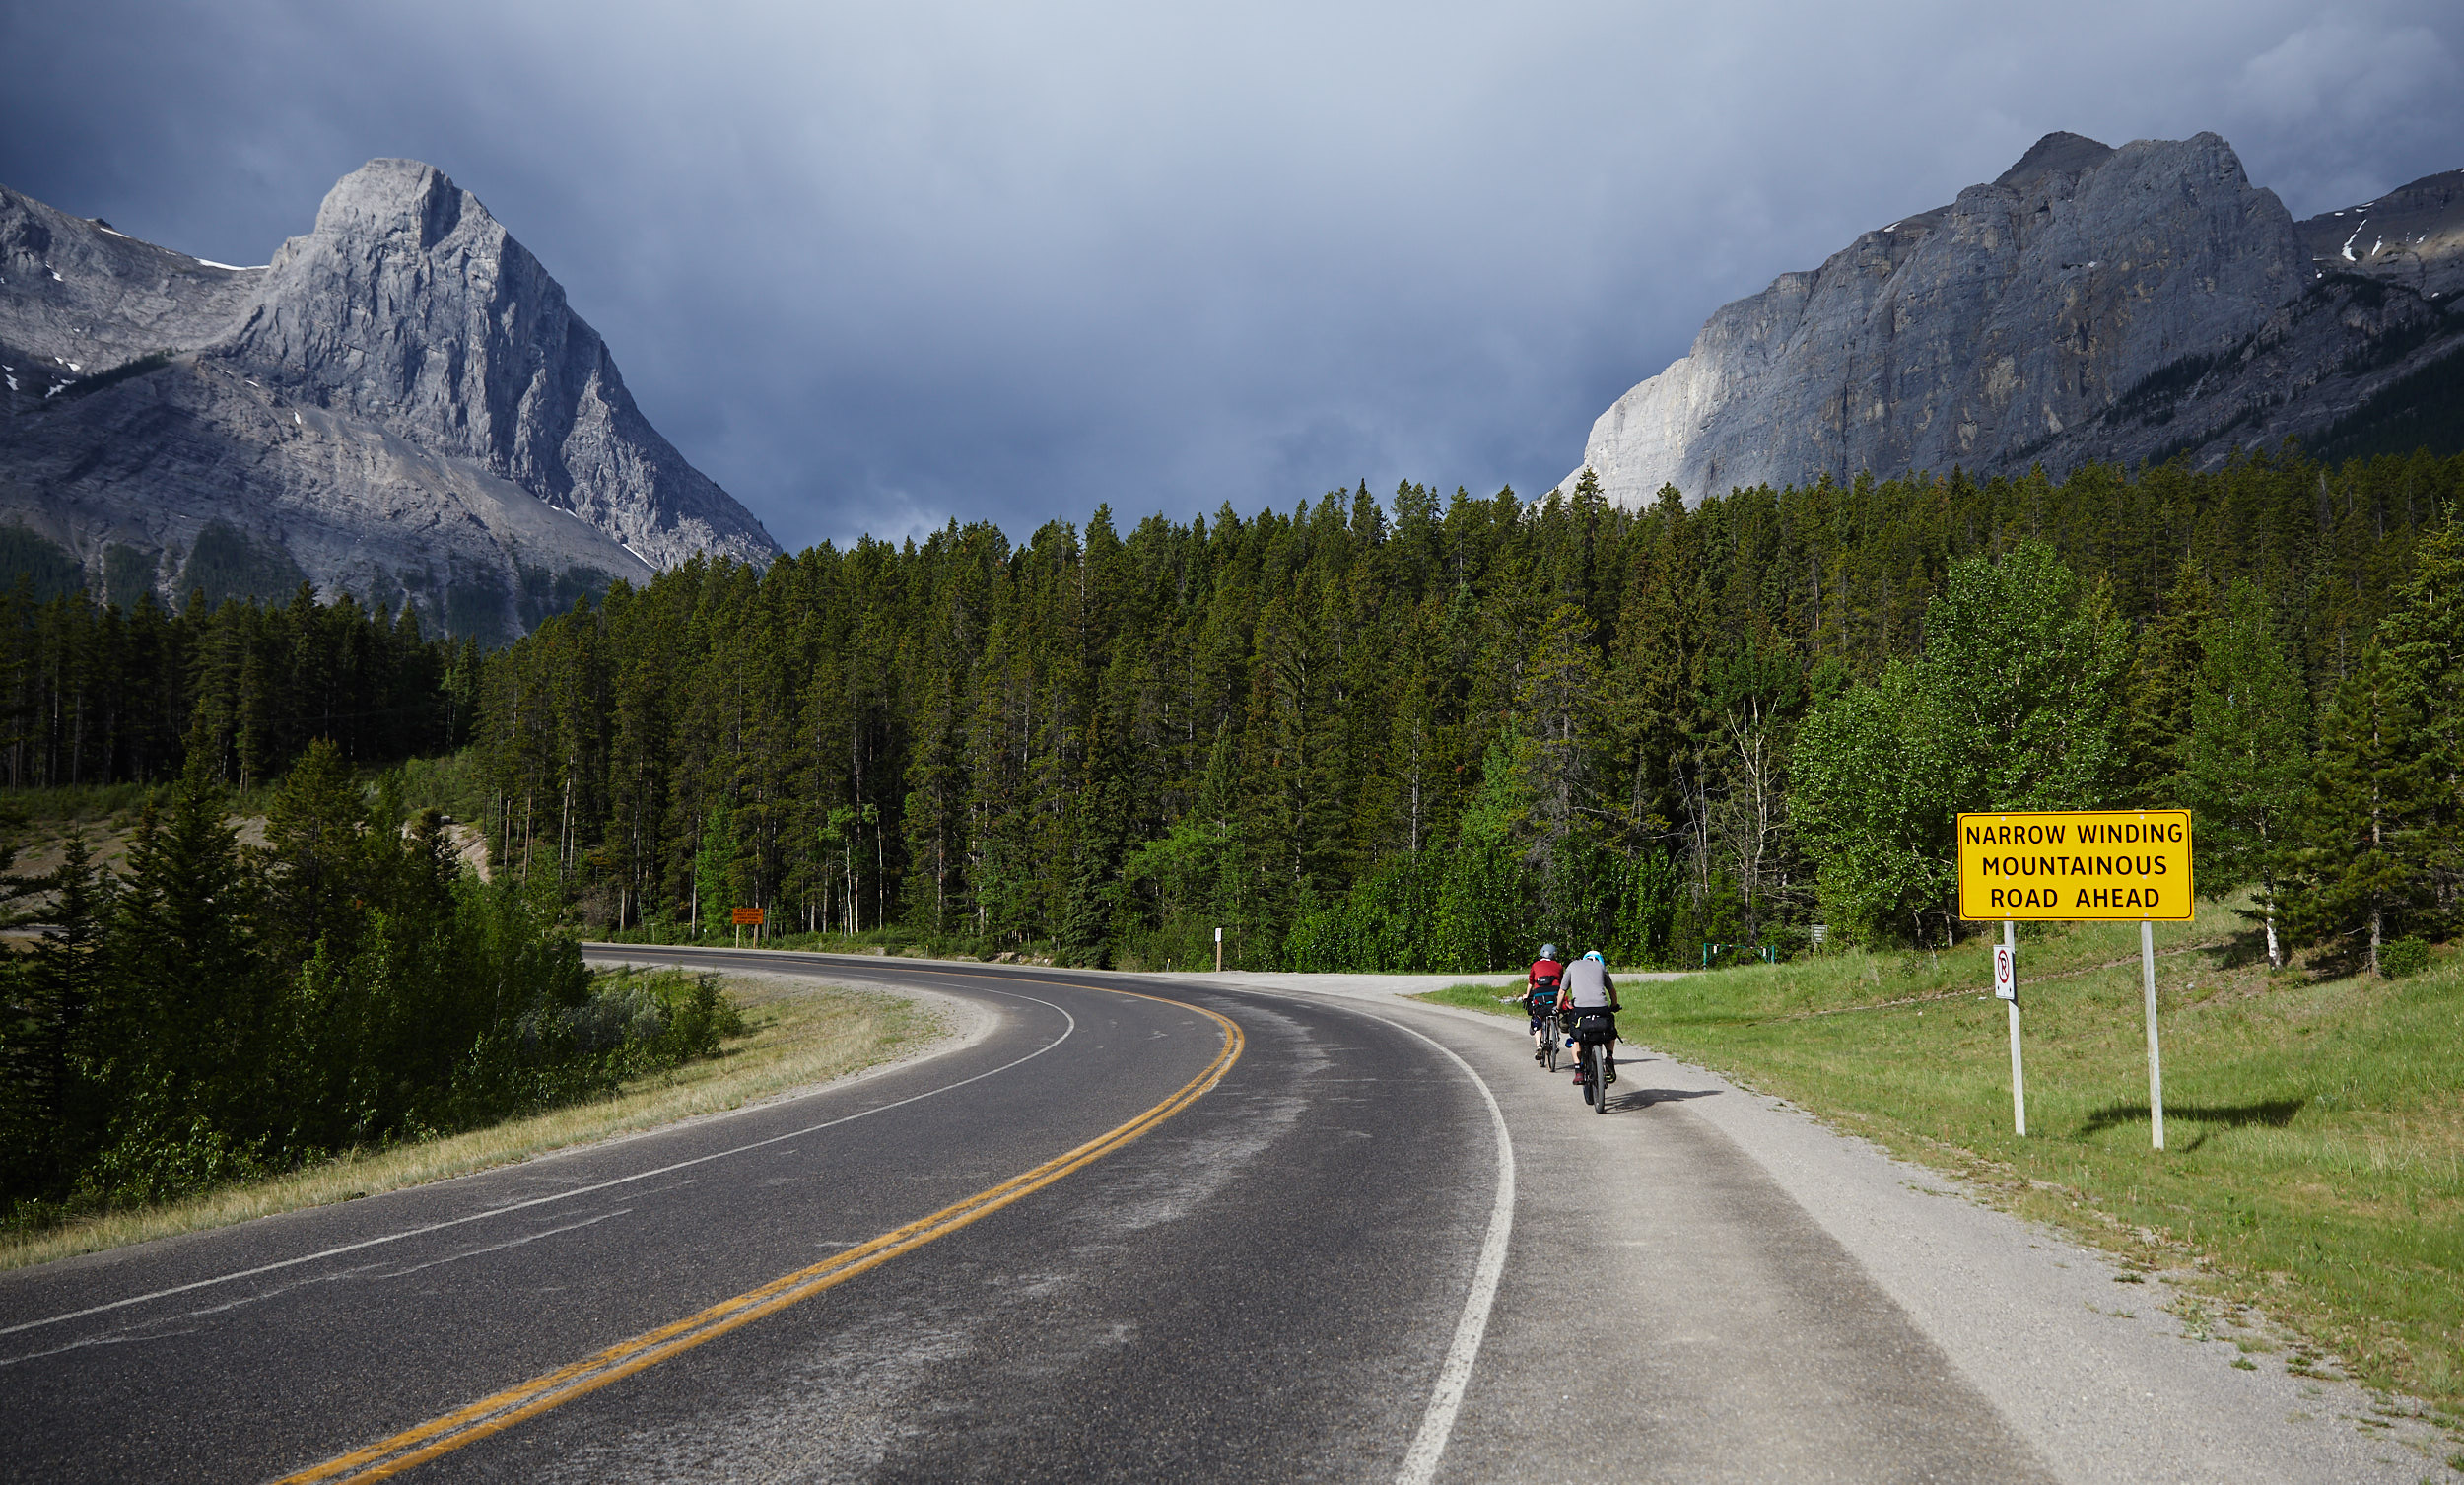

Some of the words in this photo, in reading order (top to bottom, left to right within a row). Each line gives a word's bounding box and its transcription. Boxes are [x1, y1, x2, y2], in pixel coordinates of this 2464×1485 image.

[1966, 825, 2066, 844] NARROW
[2077, 823, 2183, 844] WINDING
[1982, 855, 2167, 876] MOUNTAINOUS
[1991, 888, 2058, 908] ROAD
[2075, 888, 2159, 908] AHEAD
